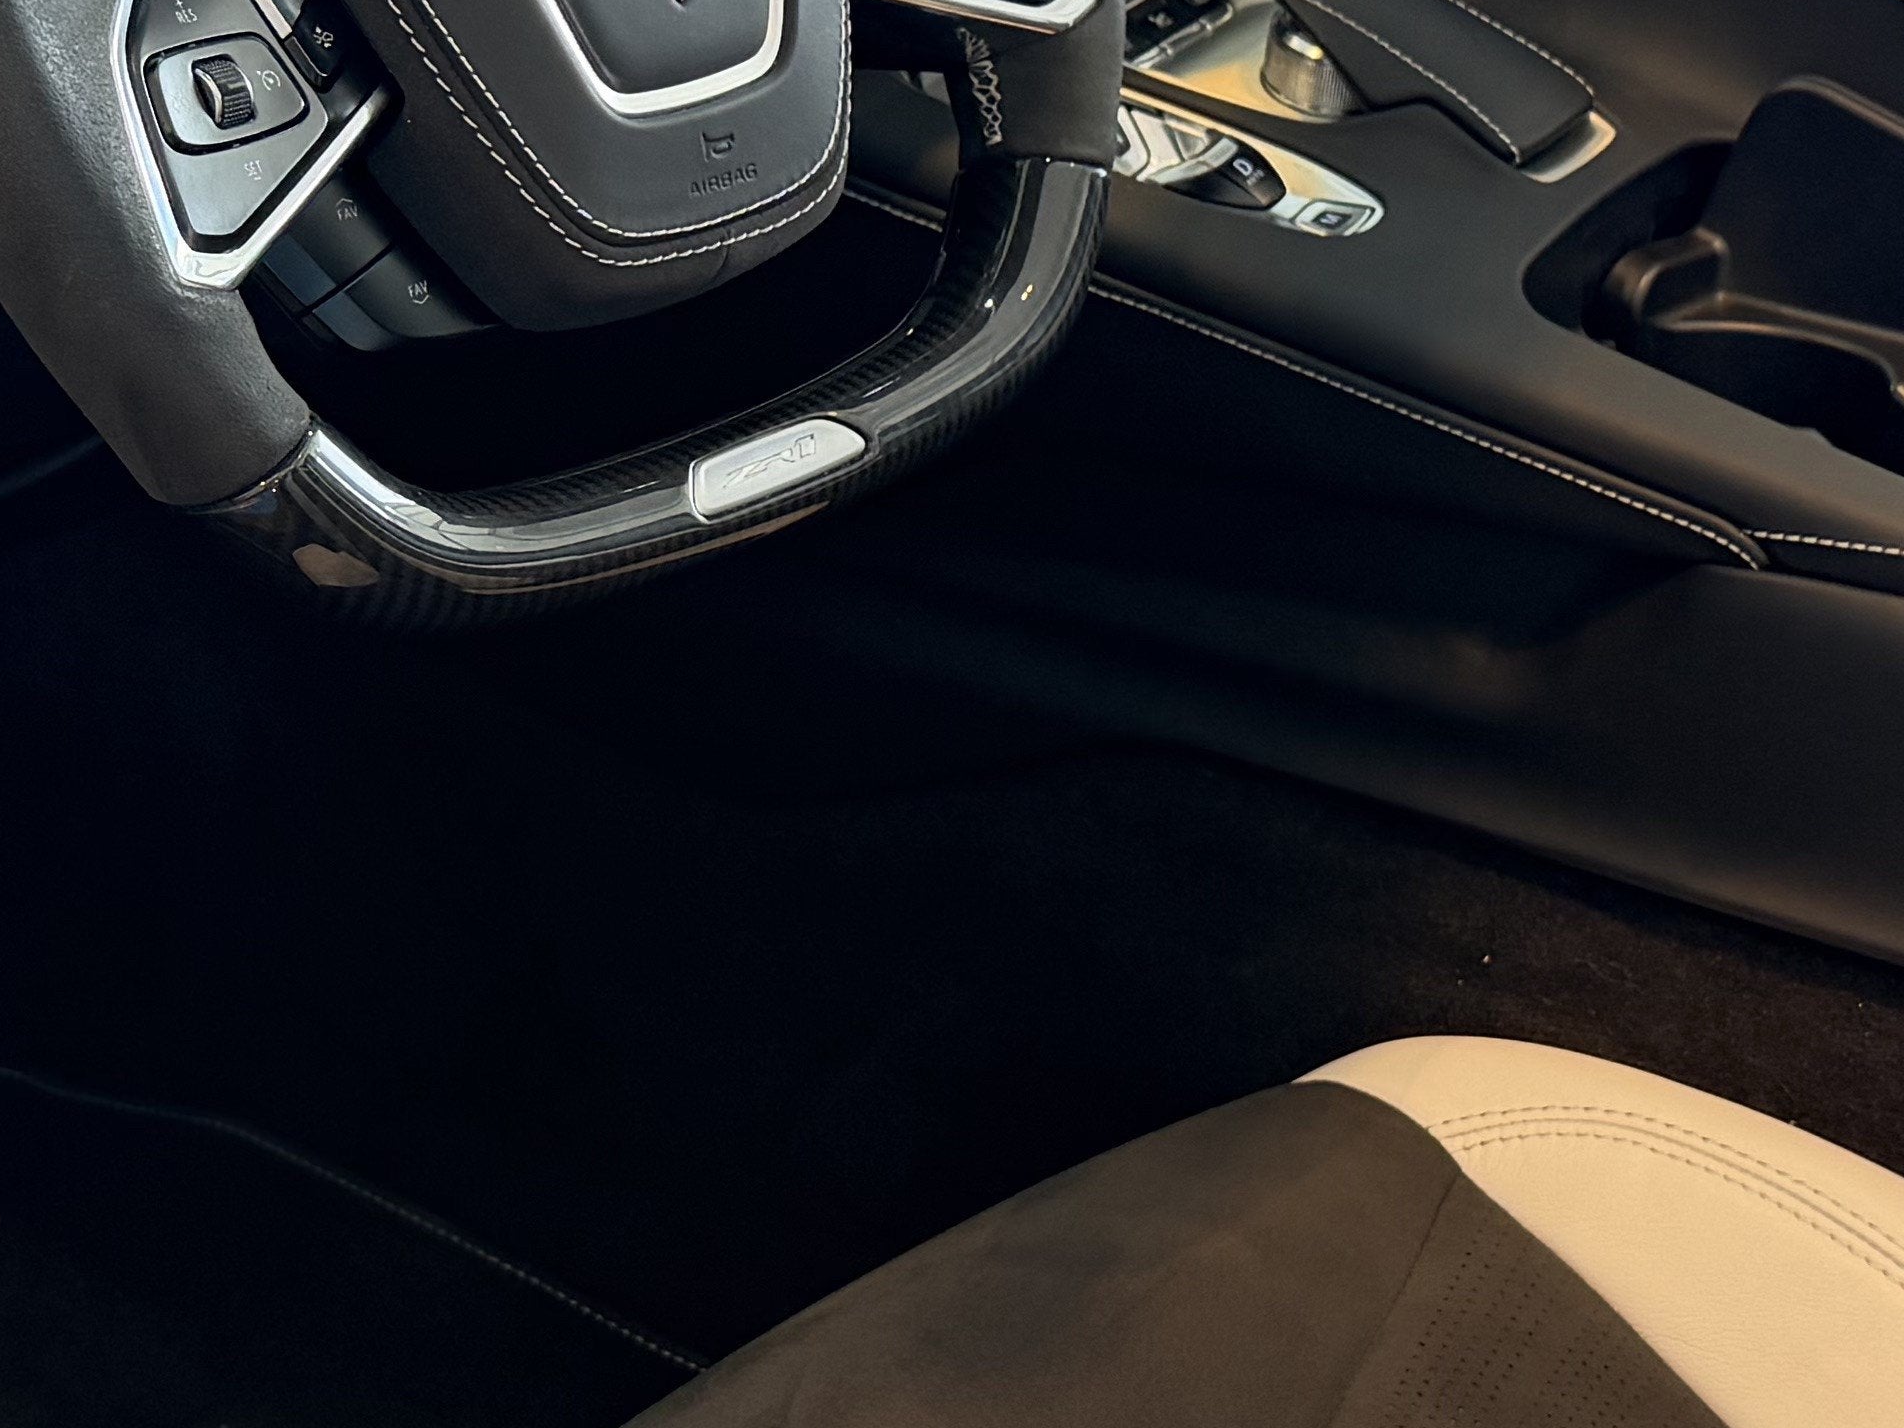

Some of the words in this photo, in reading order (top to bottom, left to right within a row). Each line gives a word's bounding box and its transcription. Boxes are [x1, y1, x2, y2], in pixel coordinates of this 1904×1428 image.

[175, 8, 198, 24] RES
[244, 159, 262, 175] SET
[688, 162, 759, 198] AIRBAG
[337, 206, 358, 221] FAV
[407, 279, 429, 299] FAV
